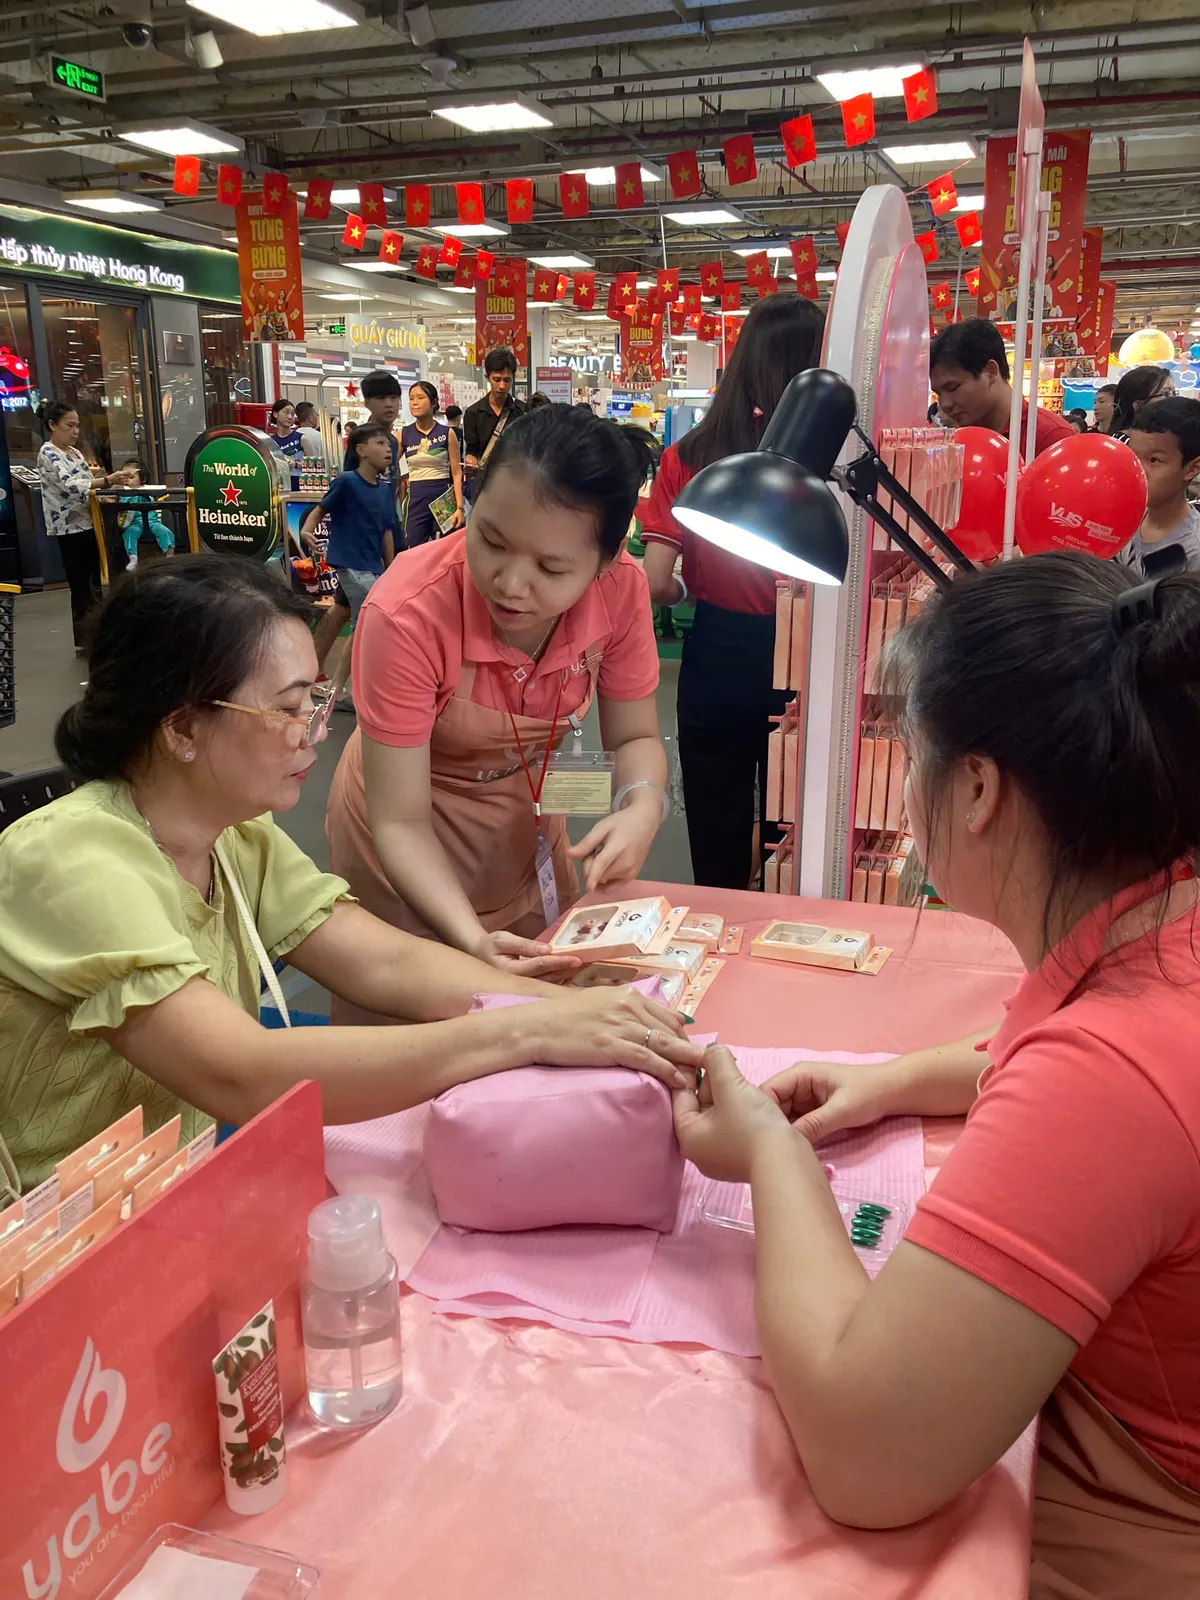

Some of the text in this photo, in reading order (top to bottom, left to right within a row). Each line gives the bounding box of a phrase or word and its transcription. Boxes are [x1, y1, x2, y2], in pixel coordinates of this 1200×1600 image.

[30, 245, 65, 272] thủy
[69, 252, 106, 278] nhiệt
[109, 258, 147, 287] Hong
[150, 265, 184, 292] Kong
[387, 325, 409, 348] GIỮ
[408, 326, 426, 350] ĐỒ
[203, 463, 258, 476] The World of
[1050, 501, 1083, 528] VUS
[228, 534, 243, 542] thành
[22, 1422, 172, 1600] yabe
[68, 1456, 175, 1586] you are beautiful
